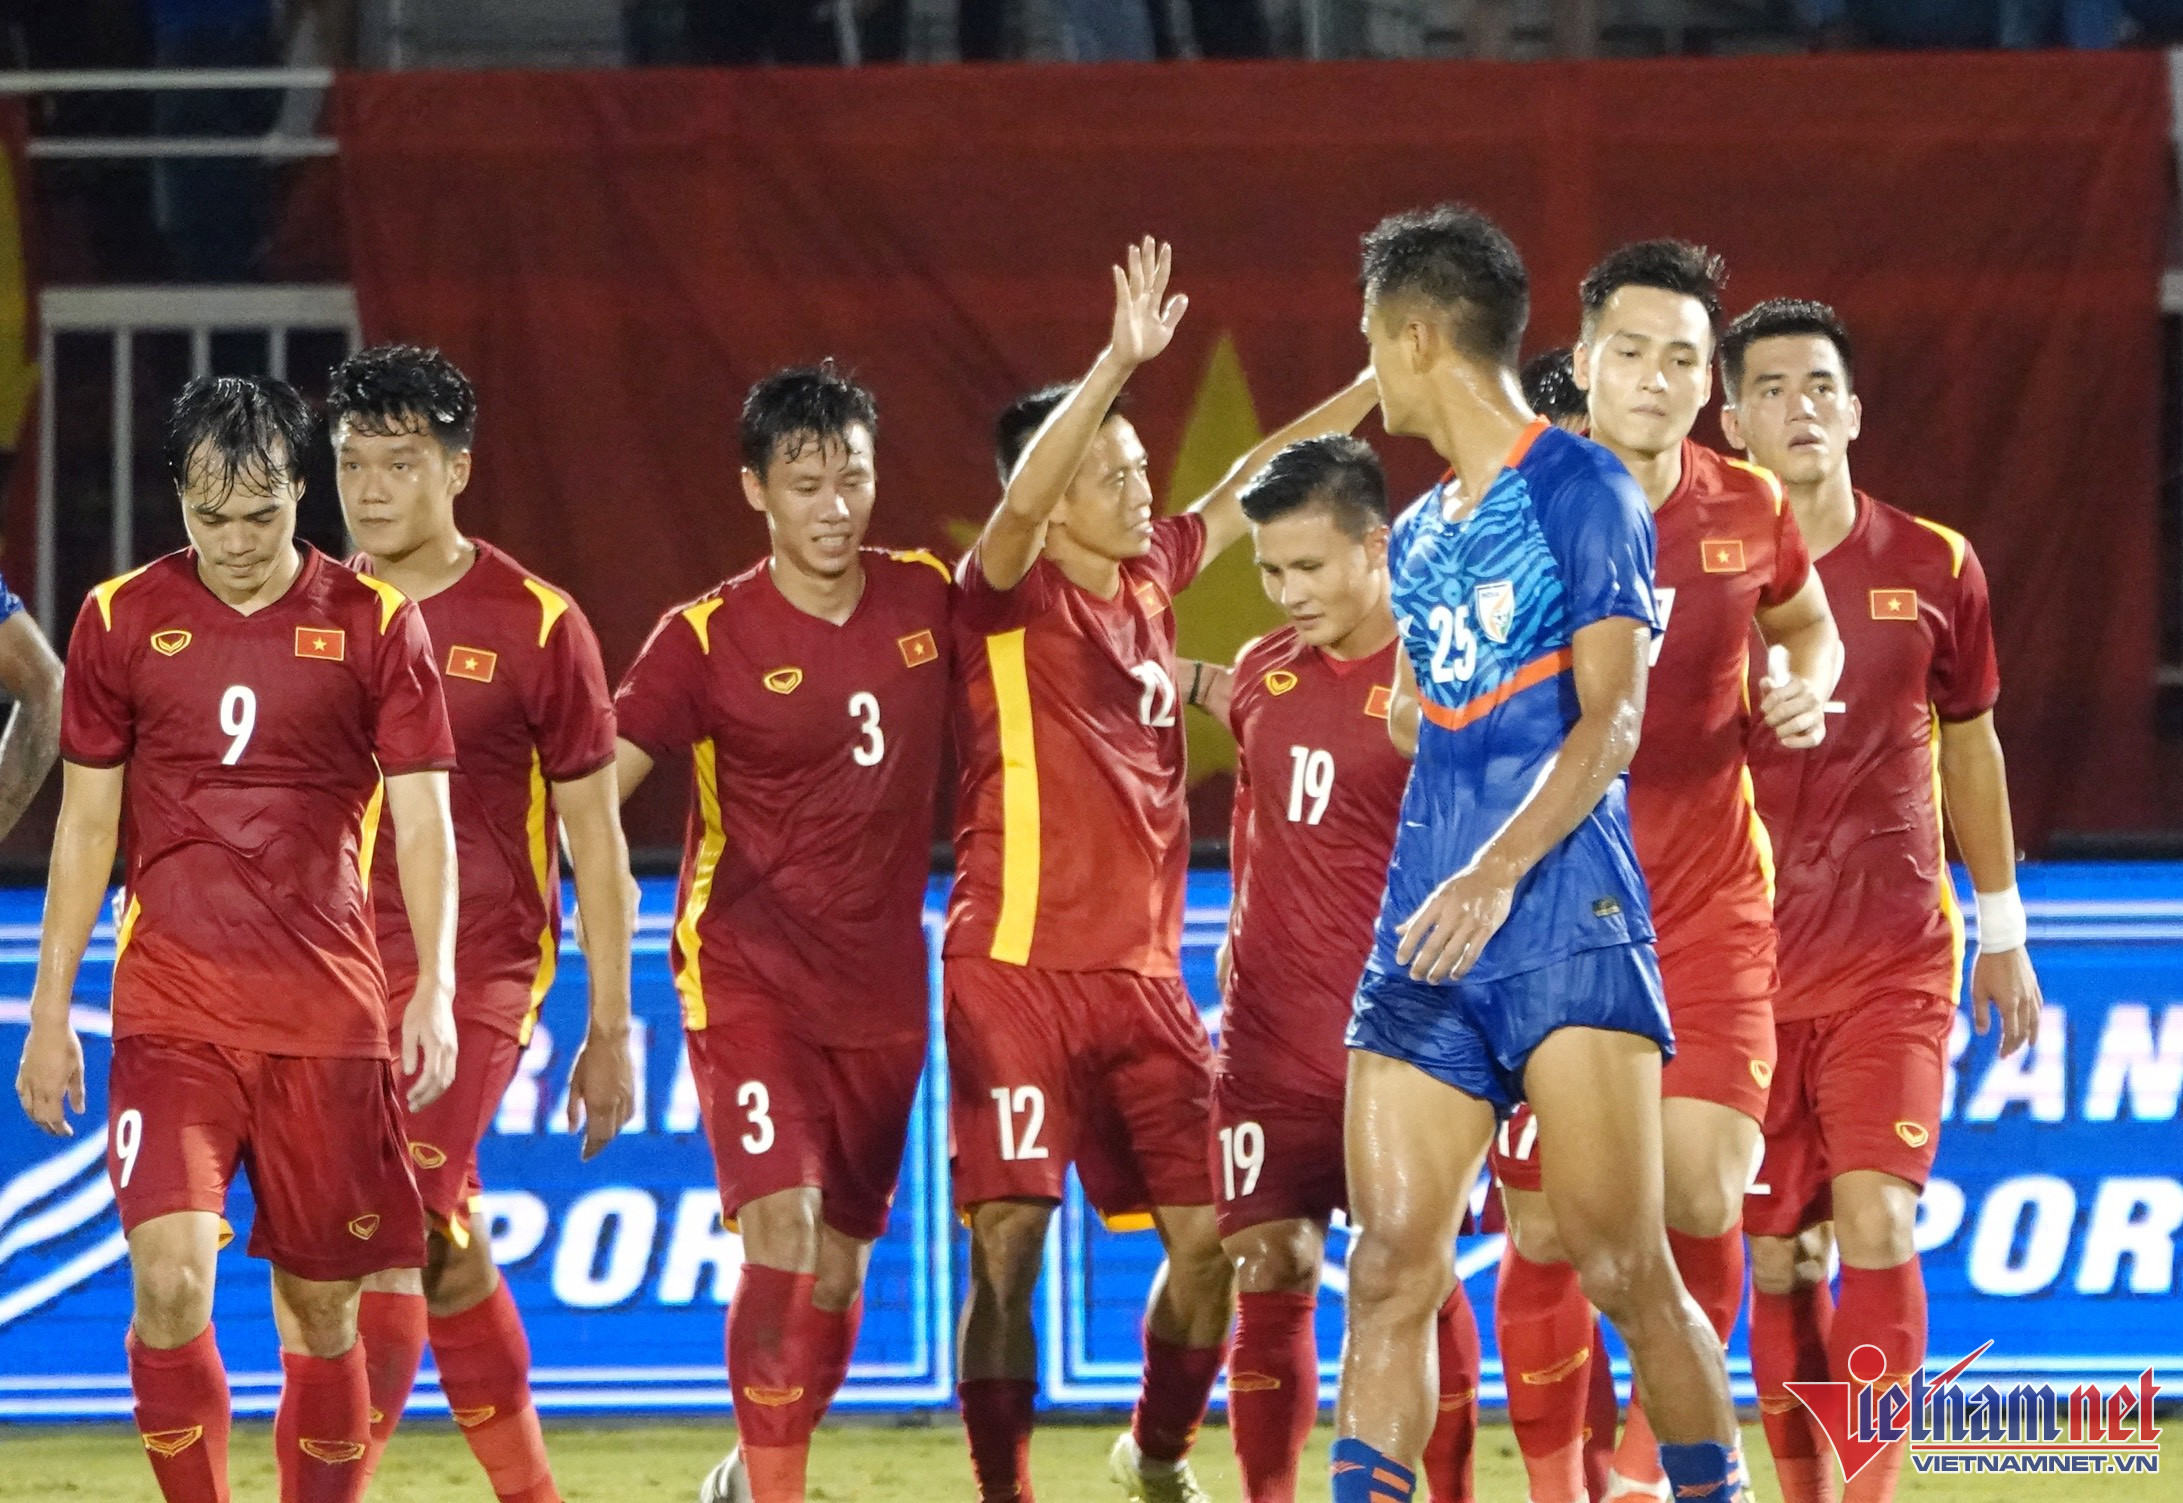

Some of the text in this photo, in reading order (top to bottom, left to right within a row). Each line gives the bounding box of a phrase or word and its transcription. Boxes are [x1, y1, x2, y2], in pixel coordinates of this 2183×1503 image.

[1428, 604, 1477, 684] 25
[219, 684, 257, 766] 9
[848, 691, 885, 767] 3
[1129, 660, 1176, 727] 12
[1288, 745, 1335, 826] 19
[115, 1109, 143, 1189] 9
[737, 1080, 775, 1155] 3
[991, 1085, 1049, 1161] 12
[1219, 1121, 1265, 1201] 19
